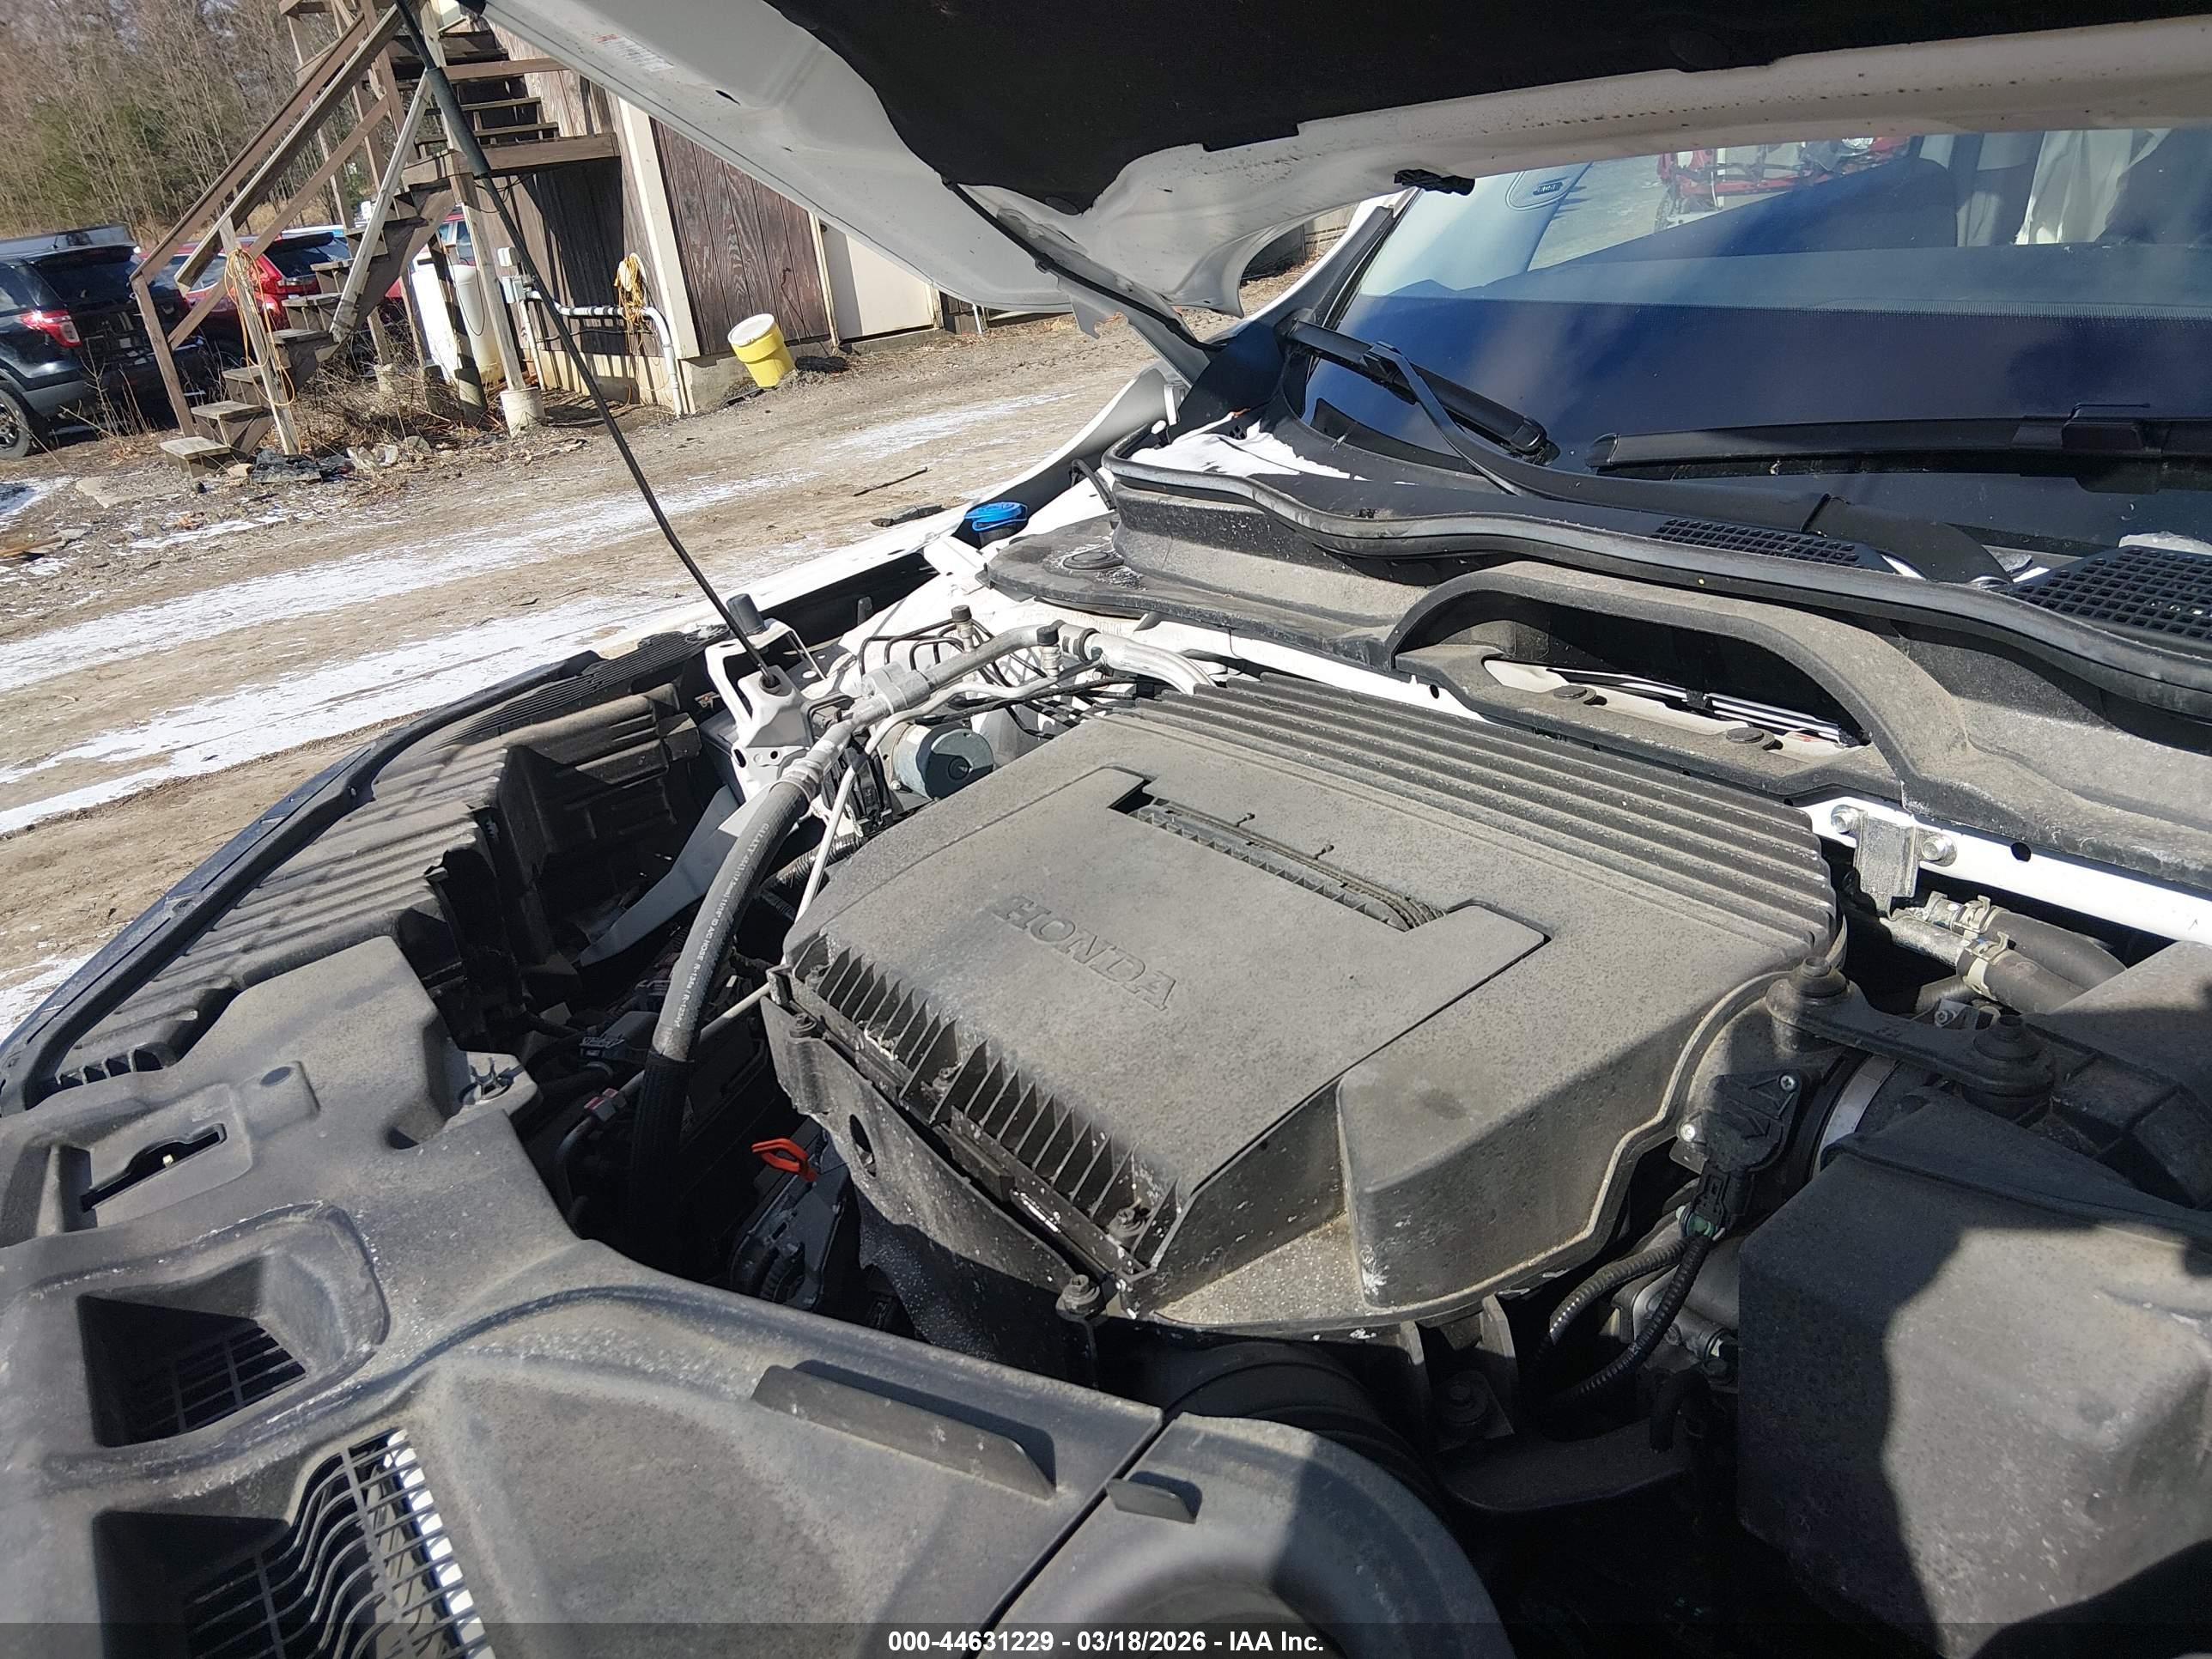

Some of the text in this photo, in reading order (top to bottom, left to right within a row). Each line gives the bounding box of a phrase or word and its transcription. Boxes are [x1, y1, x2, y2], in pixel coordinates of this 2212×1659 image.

[706, 926, 715, 939] A/C
[711, 918, 720, 927] ID
[696, 939, 710, 962] HOSE
[991, 896, 1176, 1012] HONDA
[686, 963, 701, 989] R-134a
